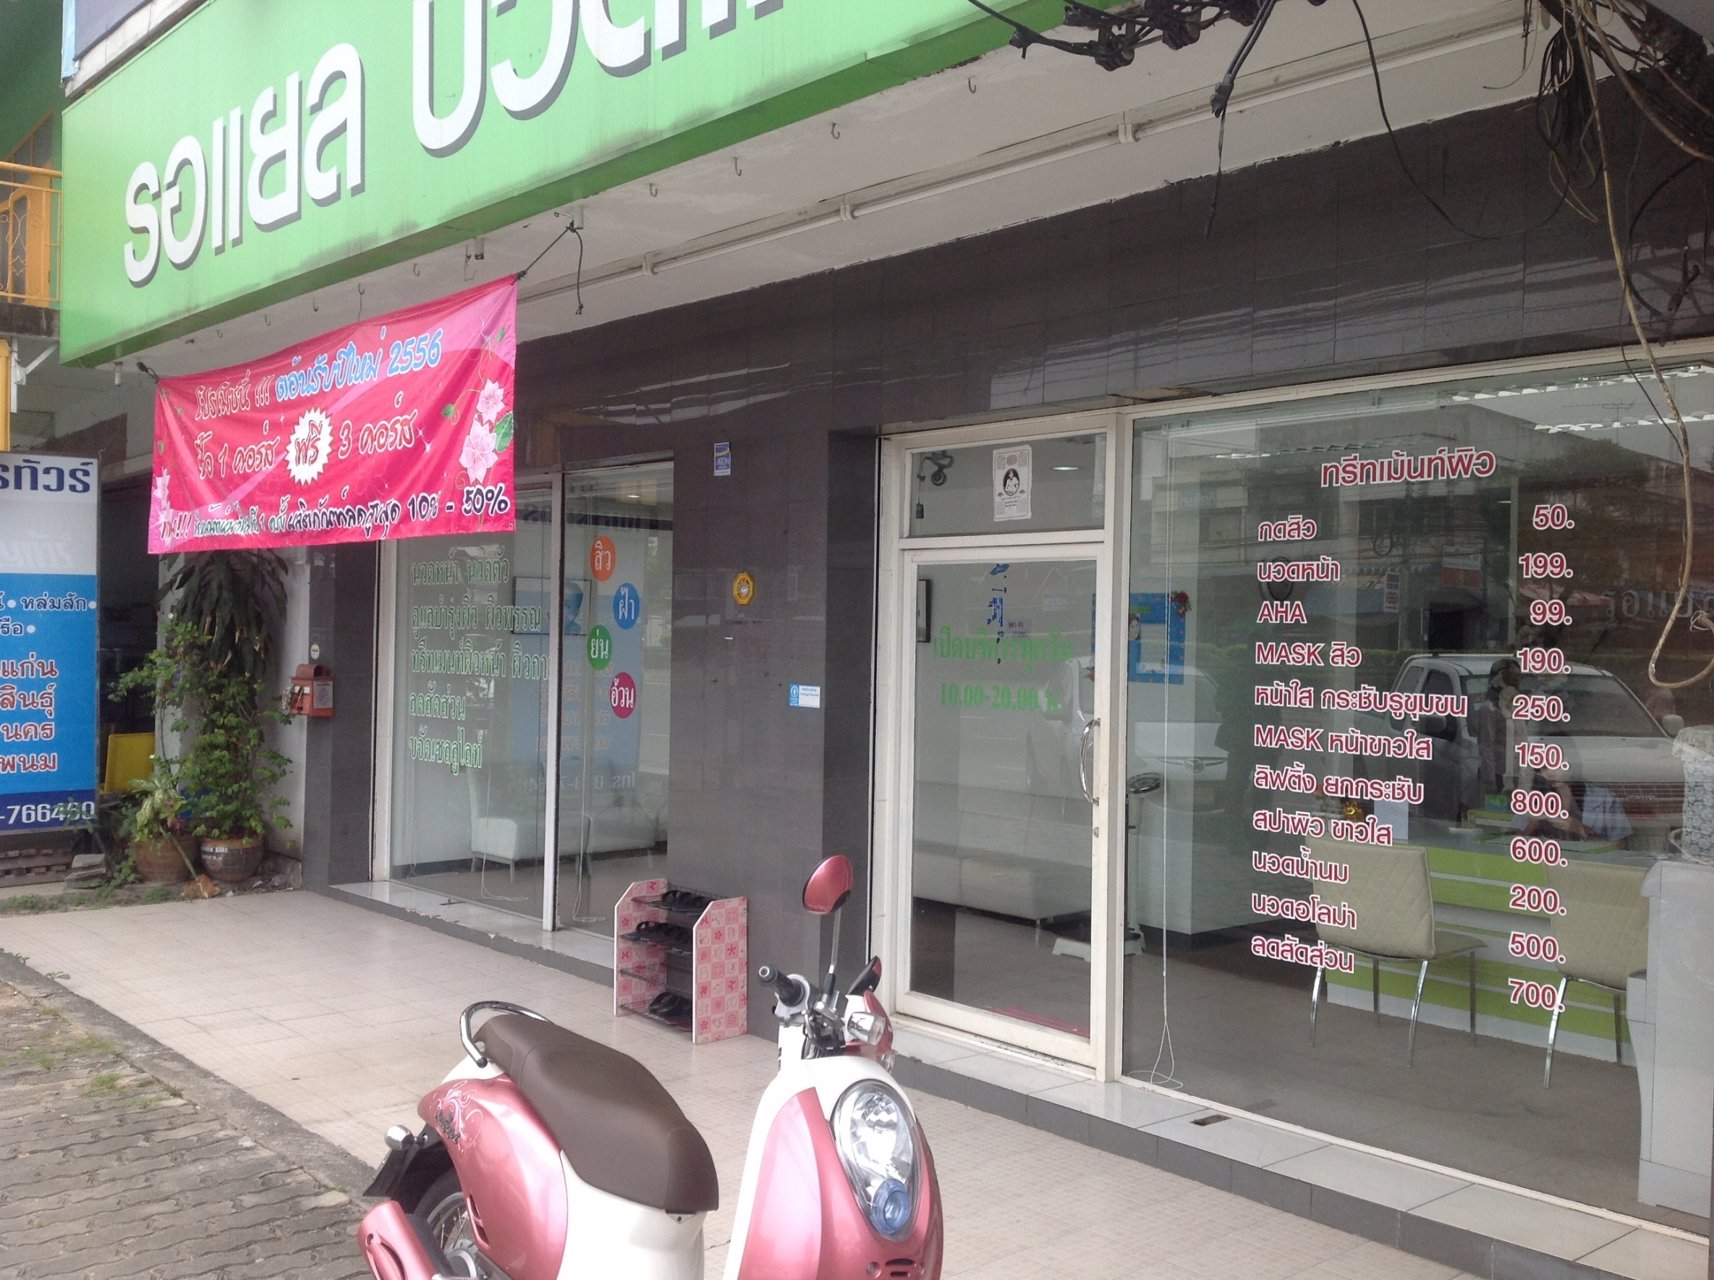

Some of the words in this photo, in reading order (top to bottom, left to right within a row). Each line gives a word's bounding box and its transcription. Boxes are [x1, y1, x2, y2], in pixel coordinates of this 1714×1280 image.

[124, 43, 364, 285] รอแยล
[387, 328, 443, 377] 2556
[218, 443, 229, 478] 1
[294, 419, 323, 467] ฟรี
[338, 420, 352, 460] 3
[1321, 447, 1496, 487] ทรีทเม้นท์ผิว
[462, 483, 510, 516] 50%
[1258, 515, 1317, 541] กดสิว
[1533, 504, 1575, 529] 50.
[467, 545, 510, 584] นวดตัว
[594, 540, 611, 571] สิว
[1257, 555, 1340, 582] นวดหน้า
[1519, 553, 1573, 578] 199.
[21, 592, 88, 611] หล่มสัก
[485, 593, 542, 632] ผิวพรรณ
[618, 586, 635, 620] ฝ้า
[1257, 601, 1307, 623] AHA
[1531, 600, 1572, 625] 99.
[511, 640, 549, 680] ผิวกา
[590, 629, 609, 659] ย่น
[1255, 642, 1324, 666] MASK
[1330, 641, 1362, 668] สิว
[1517, 647, 1571, 673] 190.
[1, 652, 59, 679] แก่น
[0, 684, 56, 718] สินธุ์
[409, 680, 465, 720] ลดสัดส่วน
[610, 678, 634, 708] อ้วน
[1255, 679, 1313, 708] หน้าใส
[1321, 684, 1468, 721] กระชับรูขุมขน
[1513, 695, 1570, 722] 250.
[1, 722, 55, 742] นคร
[1254, 724, 1323, 751] MASK
[1328, 728, 1433, 760] หน้าขาวใส
[0, 753, 57, 774] พนม
[1515, 742, 1569, 770] 150.
[1254, 761, 1317, 793] ลิฟติ้ง
[1323, 775, 1424, 804] ยกกระชับ
[1510, 790, 1569, 819] 800.
[1253, 808, 1325, 837] สปาผิว
[1331, 814, 1393, 846] ขาวใส
[1252, 845, 1349, 883] นวดน้ำนม
[1510, 838, 1568, 867] 600.
[1251, 893, 1357, 930] นวดอโลม่า
[1509, 885, 1567, 916] 200.
[1251, 934, 1355, 974] ลดสัดส่วน
[1509, 931, 1566, 964] 500.
[1508, 978, 1566, 1012] 700.
